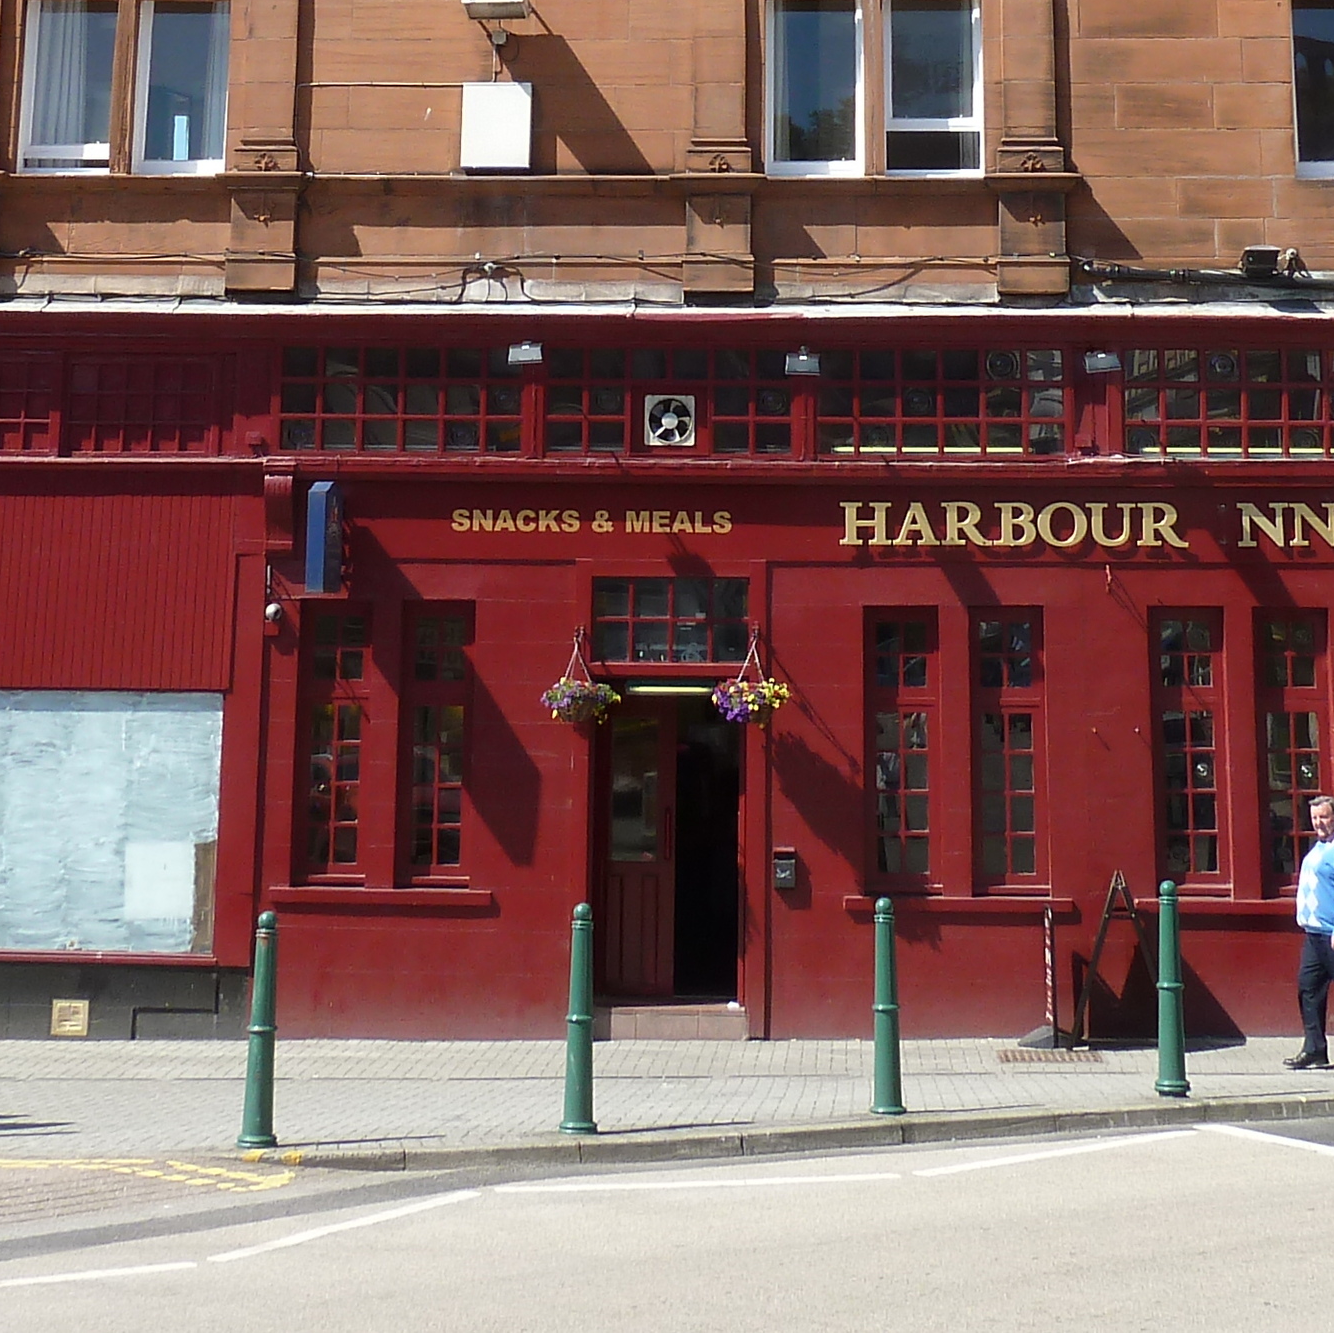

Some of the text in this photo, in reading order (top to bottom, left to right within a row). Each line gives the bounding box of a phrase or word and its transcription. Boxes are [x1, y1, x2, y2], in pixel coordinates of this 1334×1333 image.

[451, 509, 733, 534] SNACKS & MEALS
[839, 501, 1190, 549] HARBOUR
